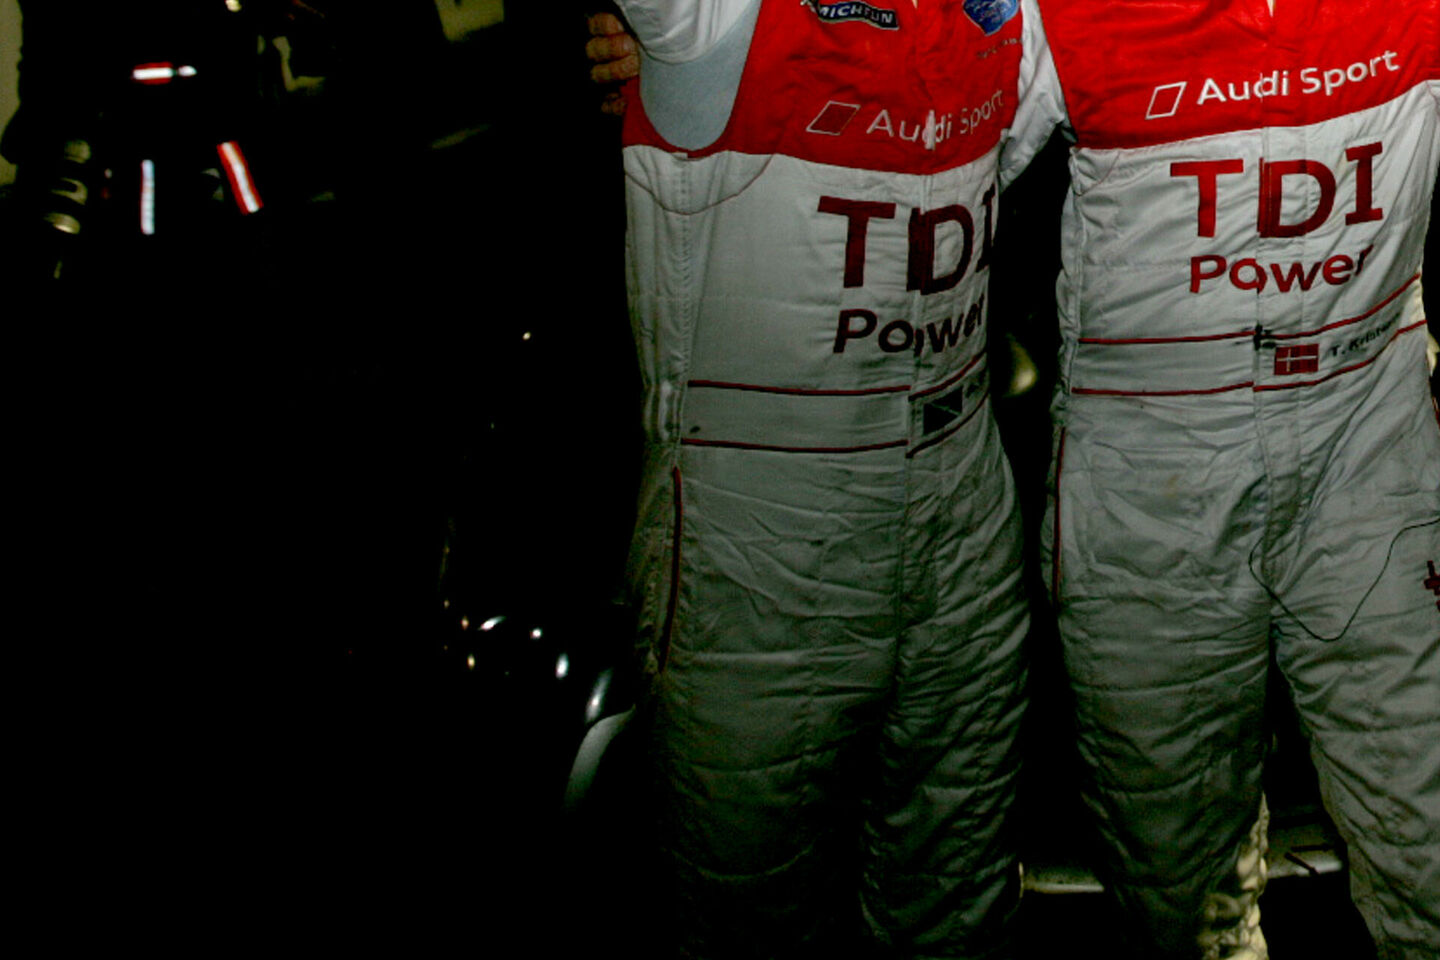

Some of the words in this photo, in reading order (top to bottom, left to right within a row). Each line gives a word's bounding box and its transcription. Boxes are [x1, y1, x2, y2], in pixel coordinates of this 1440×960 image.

[1197, 70, 1289, 105] Audi
[1301, 50, 1400, 96] Sport
[866, 109, 953, 150] Audi
[1170, 141, 1383, 238] TDI
[817, 183, 996, 295] TDI
[1189, 245, 1374, 294] Power
[833, 293, 985, 357] Power
